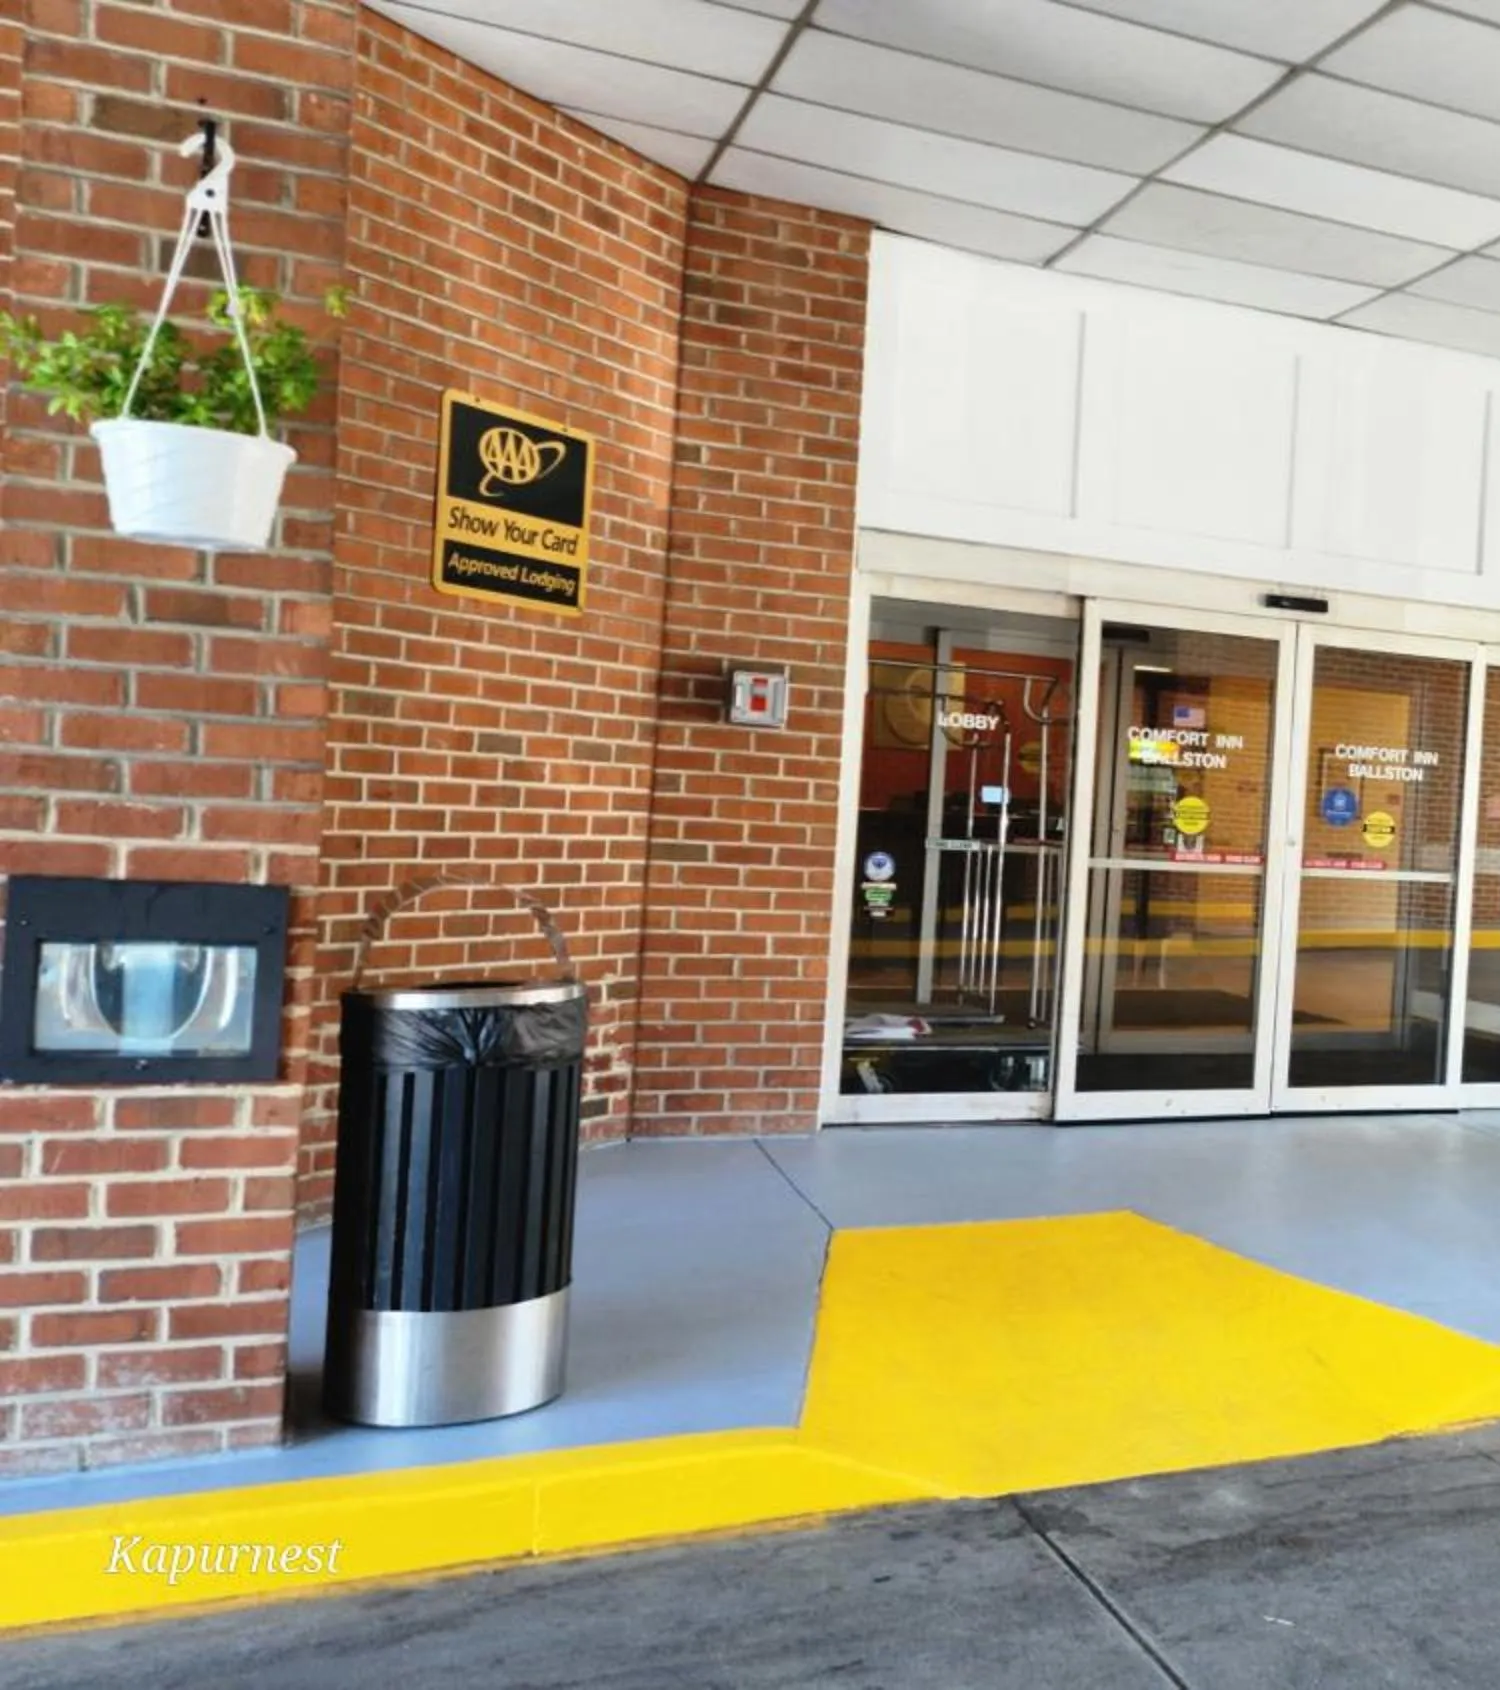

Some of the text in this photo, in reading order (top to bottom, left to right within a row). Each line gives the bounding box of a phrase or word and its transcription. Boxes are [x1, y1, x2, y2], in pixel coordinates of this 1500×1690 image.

[483, 430, 540, 484] AAA
[448, 505, 579, 556] Show Your Card
[448, 552, 576, 597] Approved Lodging
[937, 710, 999, 730] LOBBY
[1128, 726, 1244, 749] COMFORT INN
[1141, 748, 1227, 769] LLSTON
[1335, 744, 1439, 766] COMFORT INN
[1348, 763, 1424, 781] BALLSTON
